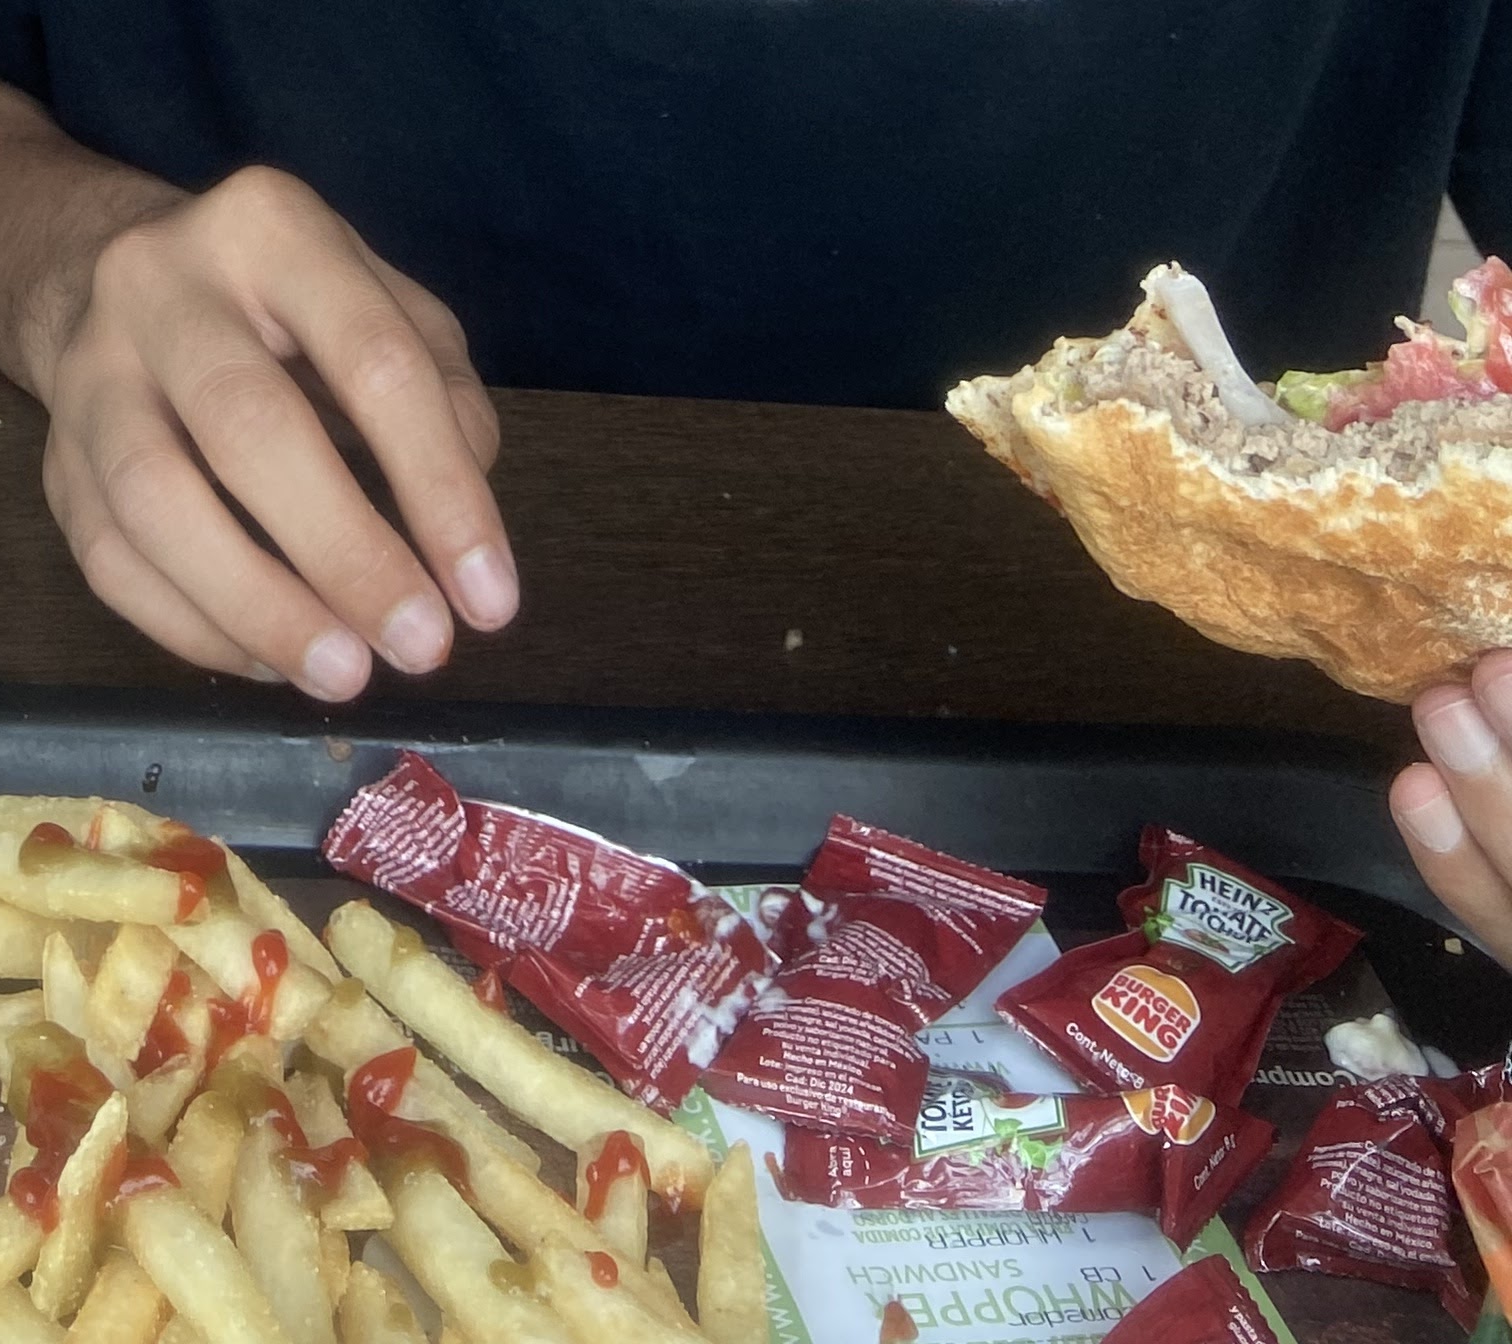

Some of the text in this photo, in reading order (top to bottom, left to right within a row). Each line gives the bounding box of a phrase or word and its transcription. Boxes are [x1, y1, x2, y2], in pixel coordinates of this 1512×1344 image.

[1199, 871, 1279, 916] HEINZ
[1100, 985, 1183, 1050] KING
[1113, 973, 1191, 1034] BURGER
[845, 1258, 1024, 1286] SANDWICH
